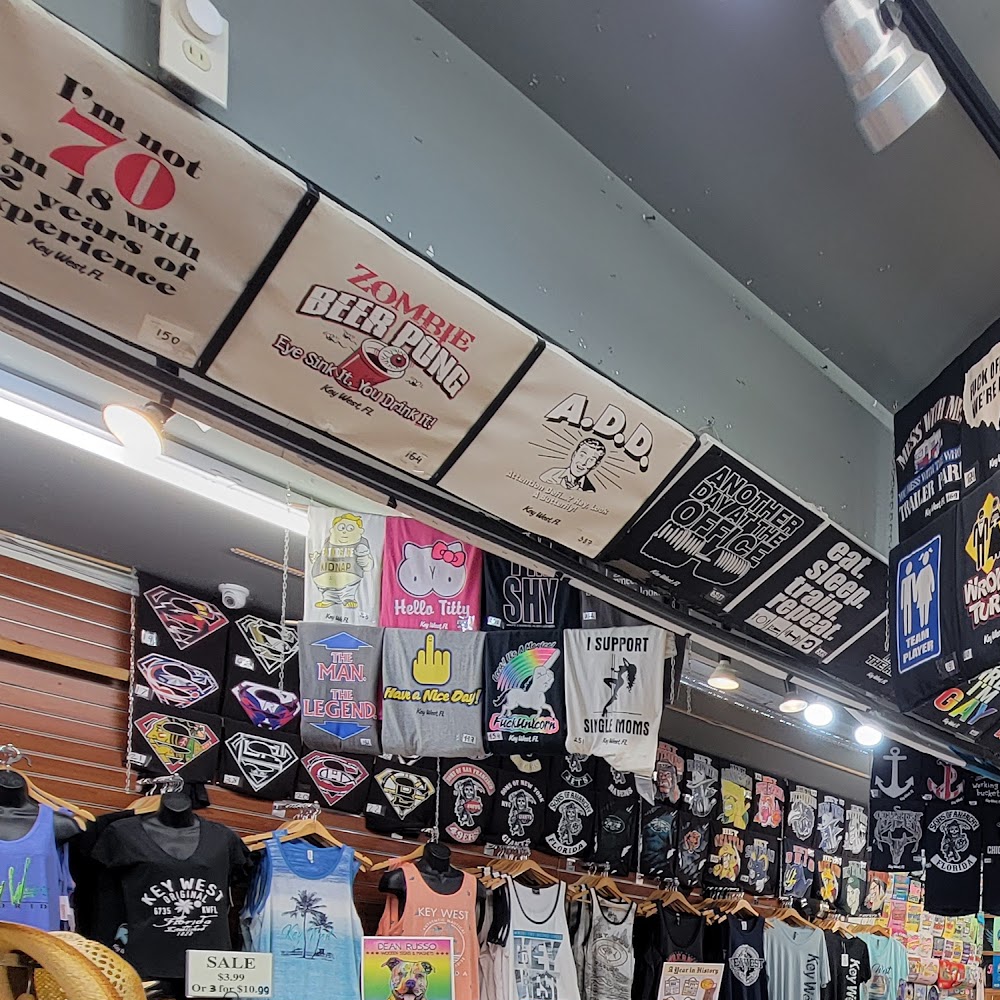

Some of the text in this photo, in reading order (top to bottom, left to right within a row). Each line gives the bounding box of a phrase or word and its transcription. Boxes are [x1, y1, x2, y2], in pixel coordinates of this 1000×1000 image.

[57, 74, 204, 180] I'm not
[49, 107, 176, 210] 70
[0, 132, 202, 262] 'm 18 with
[0, 164, 196, 282] 2 years of
[0, 197, 177, 297] perience
[27, 237, 54, 258] Key
[347, 263, 476, 352] ZOMBIE
[156, 327, 181, 346] 150
[296, 284, 470, 400] BEER PONG
[272, 334, 304, 361] Eye
[304, 350, 339, 379] Sink
[357, 379, 382, 401] You
[381, 393, 420, 424] Drink
[416, 413, 438, 430] It!
[320, 383, 339, 401] Key
[971, 382, 996, 419] WE'RE
[544, 392, 653, 472] A.D.D.
[703, 465, 804, 535] ANOTHER
[899, 479, 935, 522] TRAILER
[689, 480, 729, 516] DAY
[754, 517, 789, 550] THE
[670, 499, 771, 568] OFFICE
[827, 541, 873, 579] eat.
[805, 560, 871, 609] sleep.
[394, 599, 470, 617] Hello Titty
[502, 576, 560, 625] SHY
[783, 575, 845, 622] train.
[420, 621, 430, 629] Key
[765, 592, 841, 640] repeat.
[586, 637, 649, 652] I SUPPORT
[905, 628, 930, 648] TEAM
[331, 651, 353, 664] THE
[902, 640, 934, 664] PLAYER
[330, 688, 353, 701] THE
[384, 686, 482, 706] Have a Nice Day!
[966, 680, 999, 704] I'M
[934, 687, 998, 725] GAY
[615, 718, 650, 736] MOMS
[565, 773, 589, 786] JETS
[608, 784, 633, 797] RAVENS
[501, 782, 513, 797] SONS
[520, 780, 532, 790] NEW
[533, 786, 545, 803] YORK
[976, 788, 1000, 797] bucket
[929, 813, 946, 831] SONS
[952, 811, 979, 829] ANARCHY
[501, 834, 531, 846] GIANTS
[549, 834, 584, 854] FLORIDA
[935, 858, 973, 872] FLORIDA
[141, 877, 224, 906] KEY WEST
[163, 890, 207, 904] ORIGINAL
[153, 916, 211, 927] Florida
[418, 907, 469, 920] KEY WEST
[206, 956, 256, 970] SALE
[697, 967, 719, 975] History
[803, 953, 819, 980] Key
[846, 958, 861, 984] Key
[872, 963, 892, 975] West
[217, 972, 245, 982] $3.99
[191, 984, 207, 993] Or
[236, 985, 269, 995] $10.99
